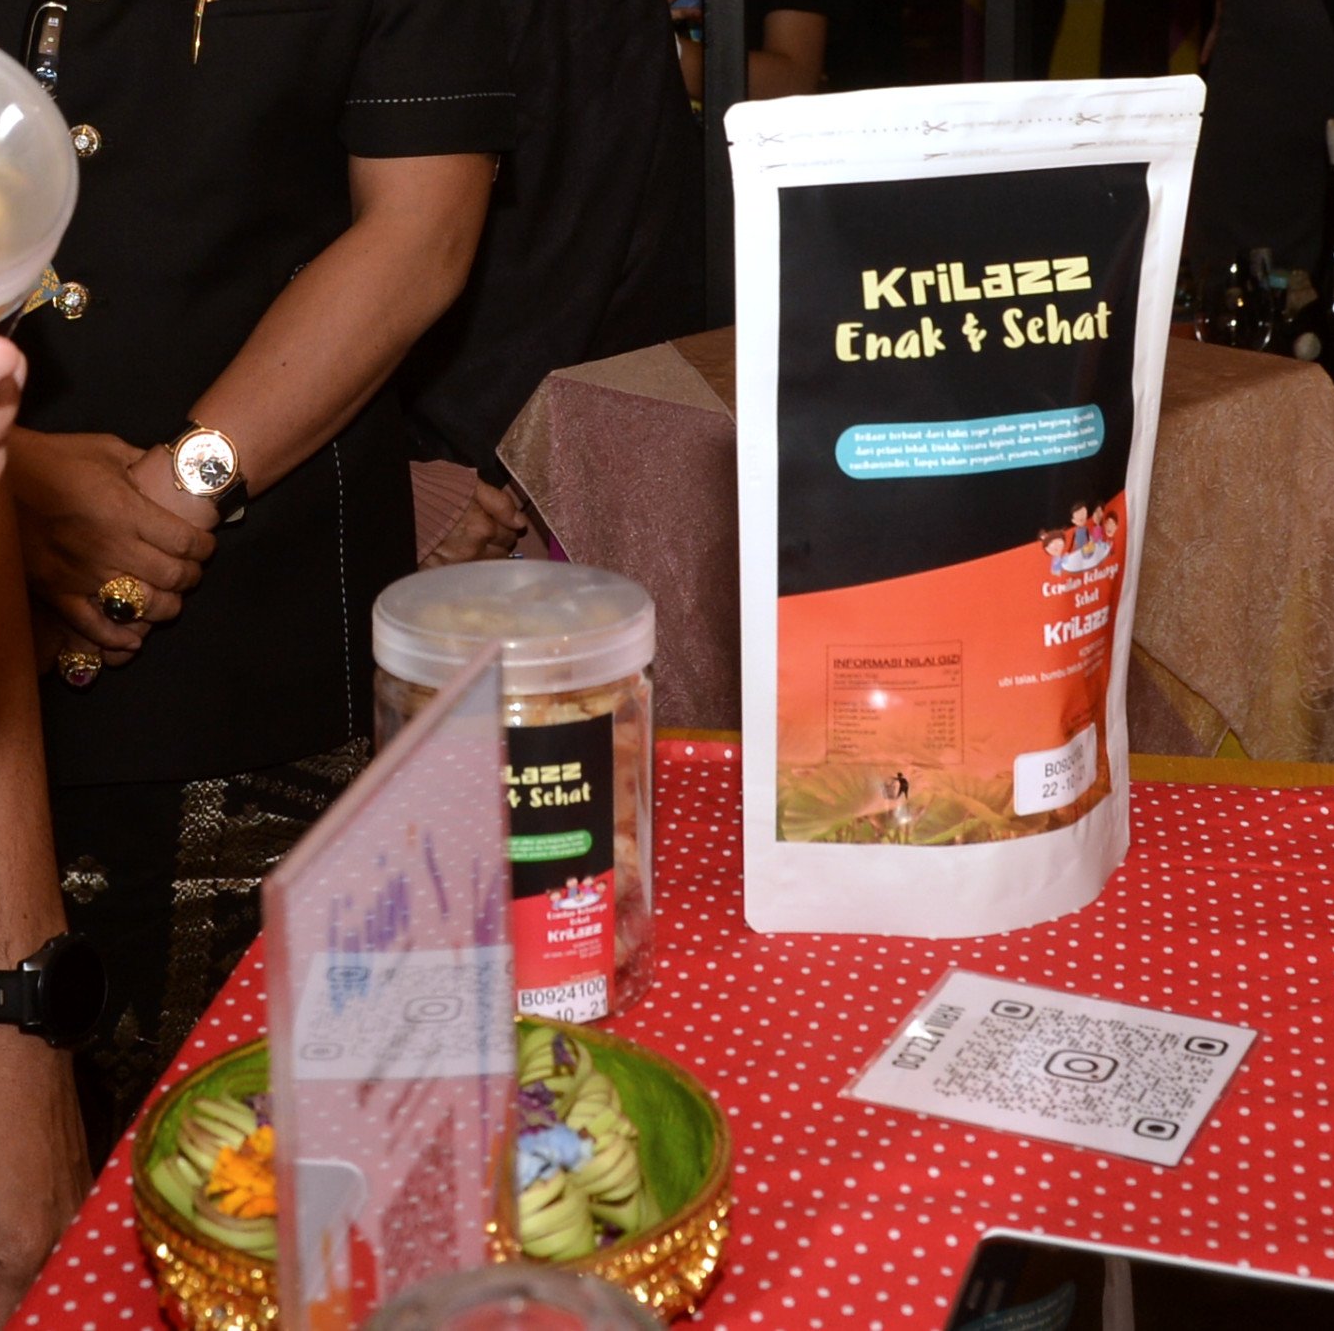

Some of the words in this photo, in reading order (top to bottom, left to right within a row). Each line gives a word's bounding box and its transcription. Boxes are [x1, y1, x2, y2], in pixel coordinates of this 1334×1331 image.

[861, 256, 1092, 310] KriLazz
[834, 317, 946, 363] Enak
[962, 313, 987, 354] &
[1002, 301, 1113, 350] Sehat
[1043, 605, 1110, 647] KriLazz
[833, 657, 903, 669] INFORMASI
[501, 762, 582, 786] Lazz
[529, 781, 592, 808] Sehat
[520, 977, 606, 1008] B0924100
